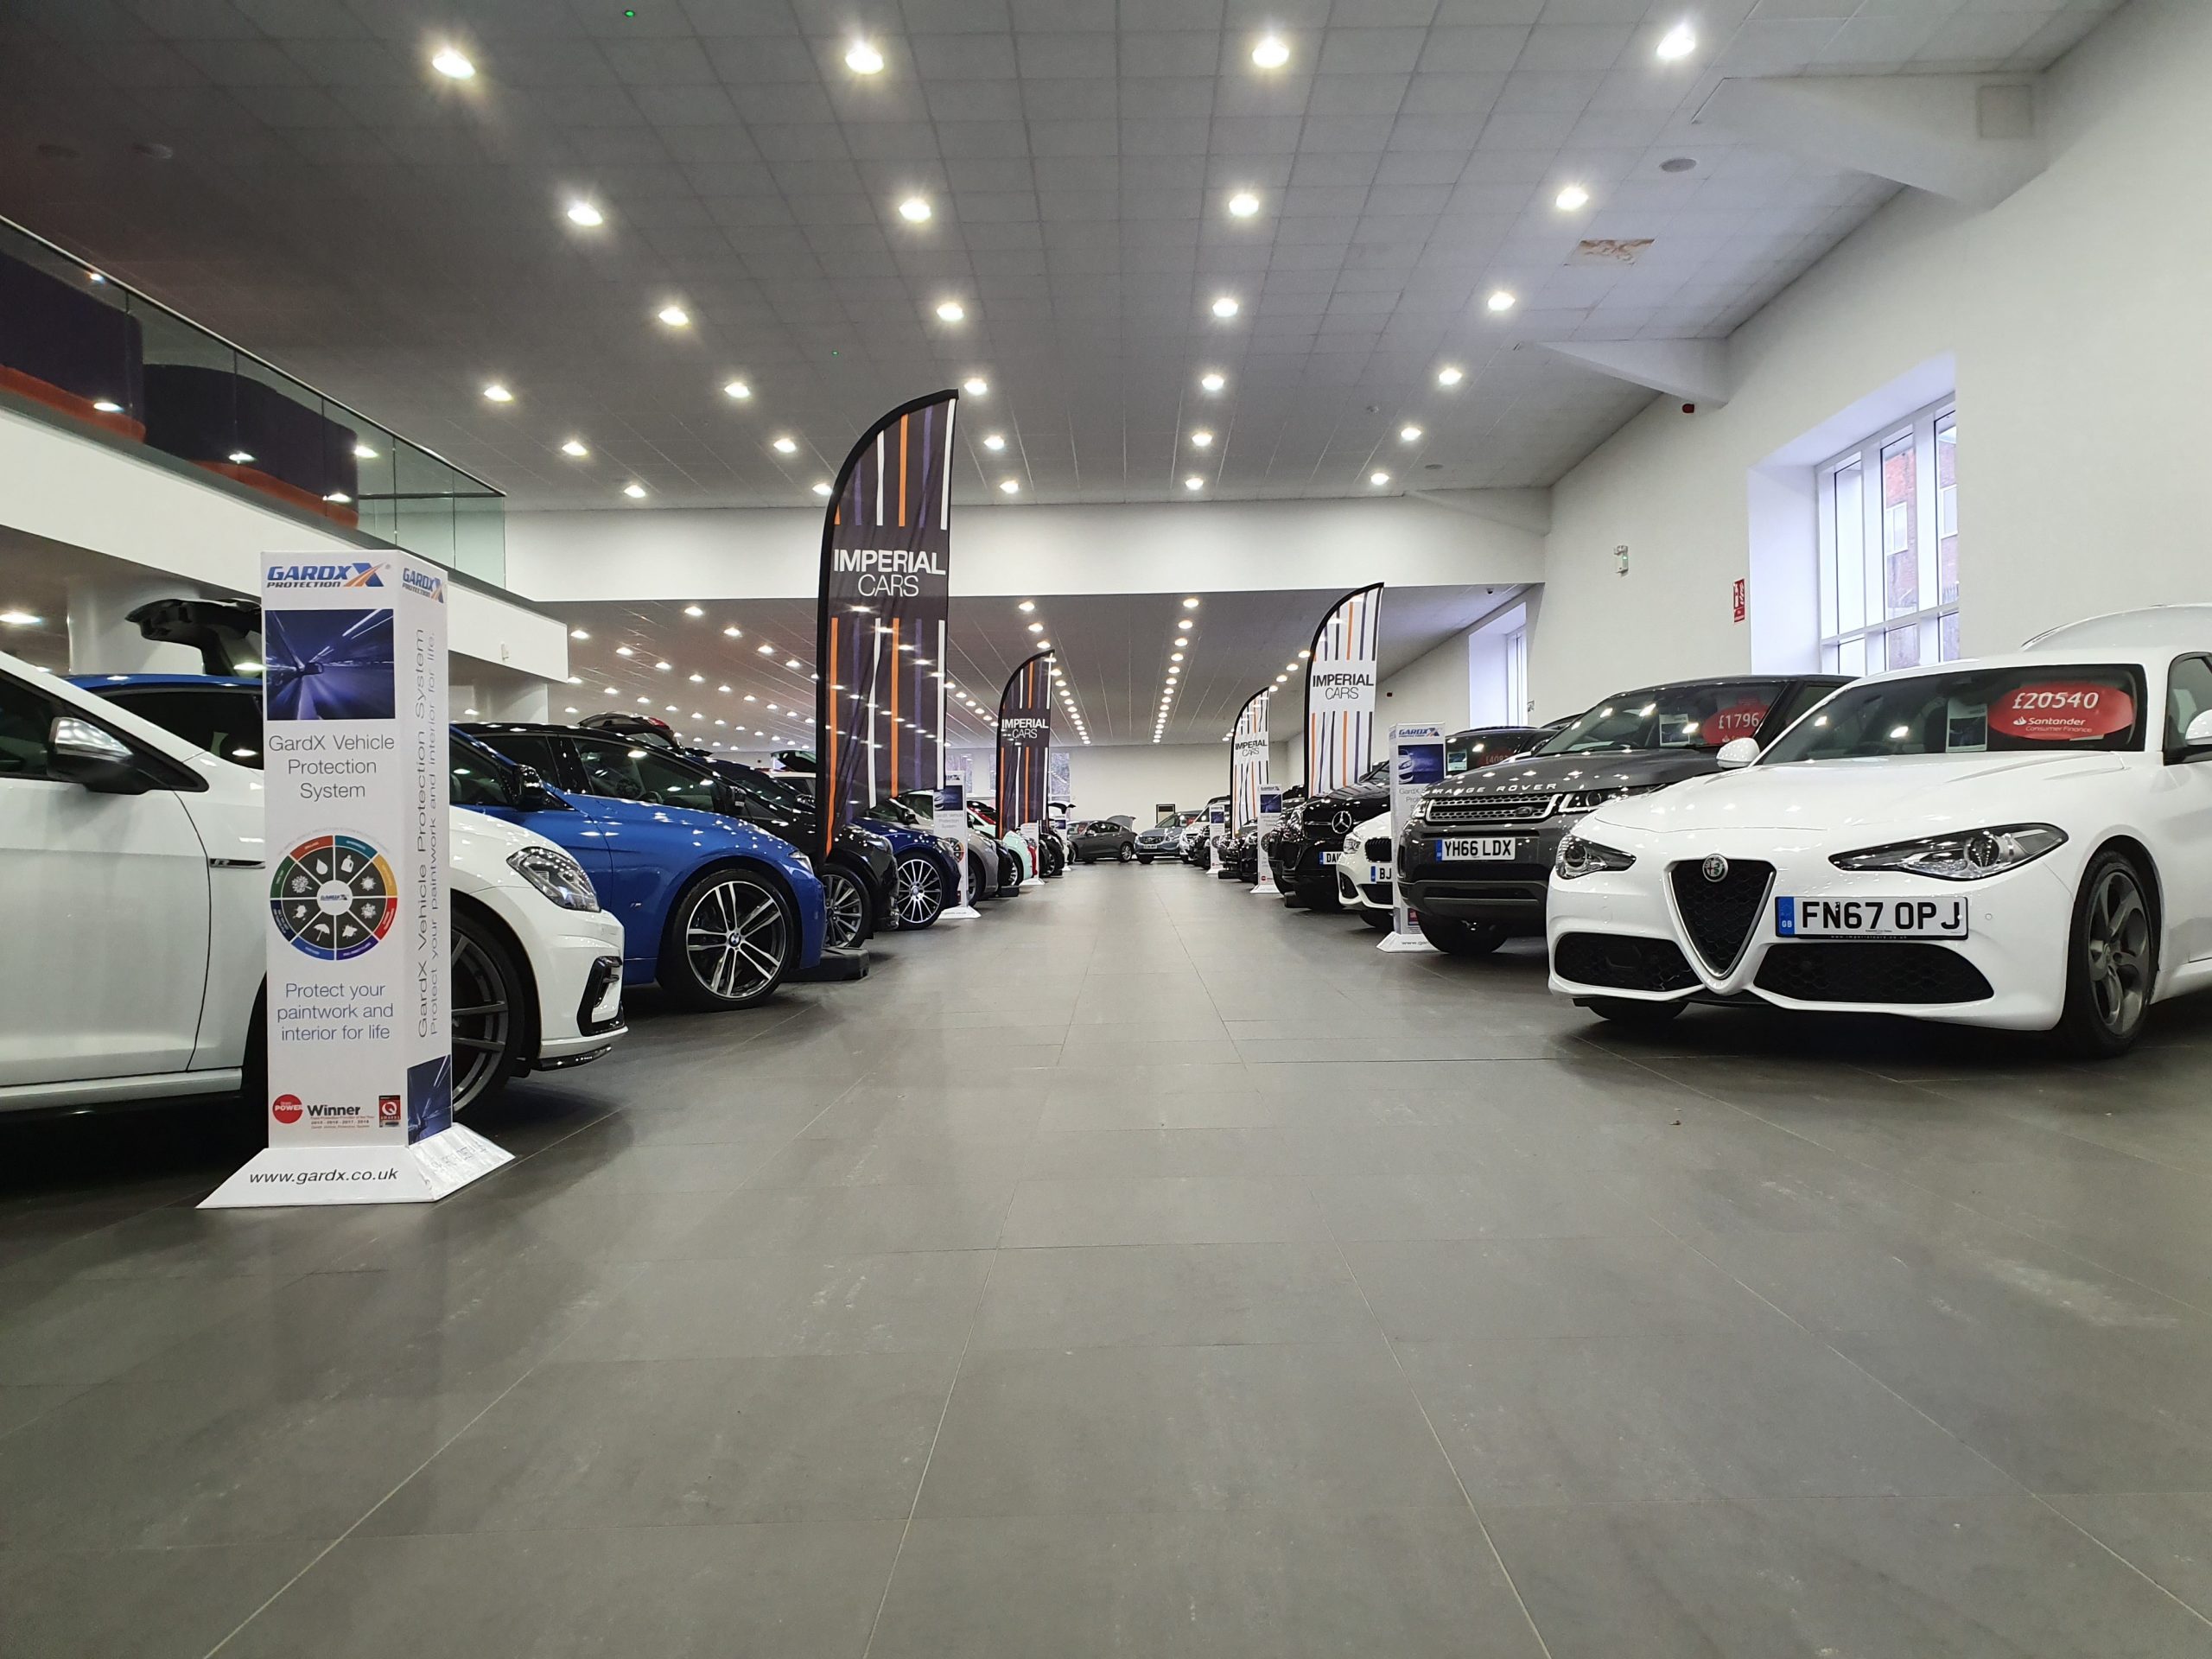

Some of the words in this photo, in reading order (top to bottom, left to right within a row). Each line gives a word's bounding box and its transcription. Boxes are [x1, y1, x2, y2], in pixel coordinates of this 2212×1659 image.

[834, 549, 946, 575] IMPERIAL
[858, 574, 919, 597] CARS
[415, 629, 427, 719] System
[1313, 674, 1374, 687] IMPERIAL
[1325, 687, 1359, 700] CARS
[2012, 692, 2099, 709] £20540
[1001, 719, 1049, 728] IMPERIAL
[2028, 717, 2086, 726] Santander
[428, 705, 436, 765] interior
[1012, 728, 1038, 739] CARS
[269, 734, 326, 752] GardX
[333, 734, 395, 750] Vehicle
[288, 759, 377, 775] Protection
[300, 782, 365, 803] System
[416, 731, 427, 852] Protection
[1496, 783, 1557, 792] ROVER
[1444, 840, 1478, 856] YH66
[1483, 840, 1511, 855] LDX
[429, 817, 439, 910] paintwork
[418, 864, 428, 950] Vehicle
[1802, 901, 1884, 929] FN67
[1894, 901, 1961, 930] OPJ
[430, 921, 439, 960] your
[285, 983, 345, 998] Protect
[349, 984, 385, 1001] your
[418, 961, 428, 1038] GardX
[277, 1003, 359, 1023] paintwork
[363, 1003, 394, 1018] and
[282, 1026, 337, 1040] interior
[342, 1025, 364, 1039] for
[368, 1024, 391, 1039] life
[307, 1104, 361, 1116] Winner
[250, 1168, 398, 1185] www.gardx.co.uk
